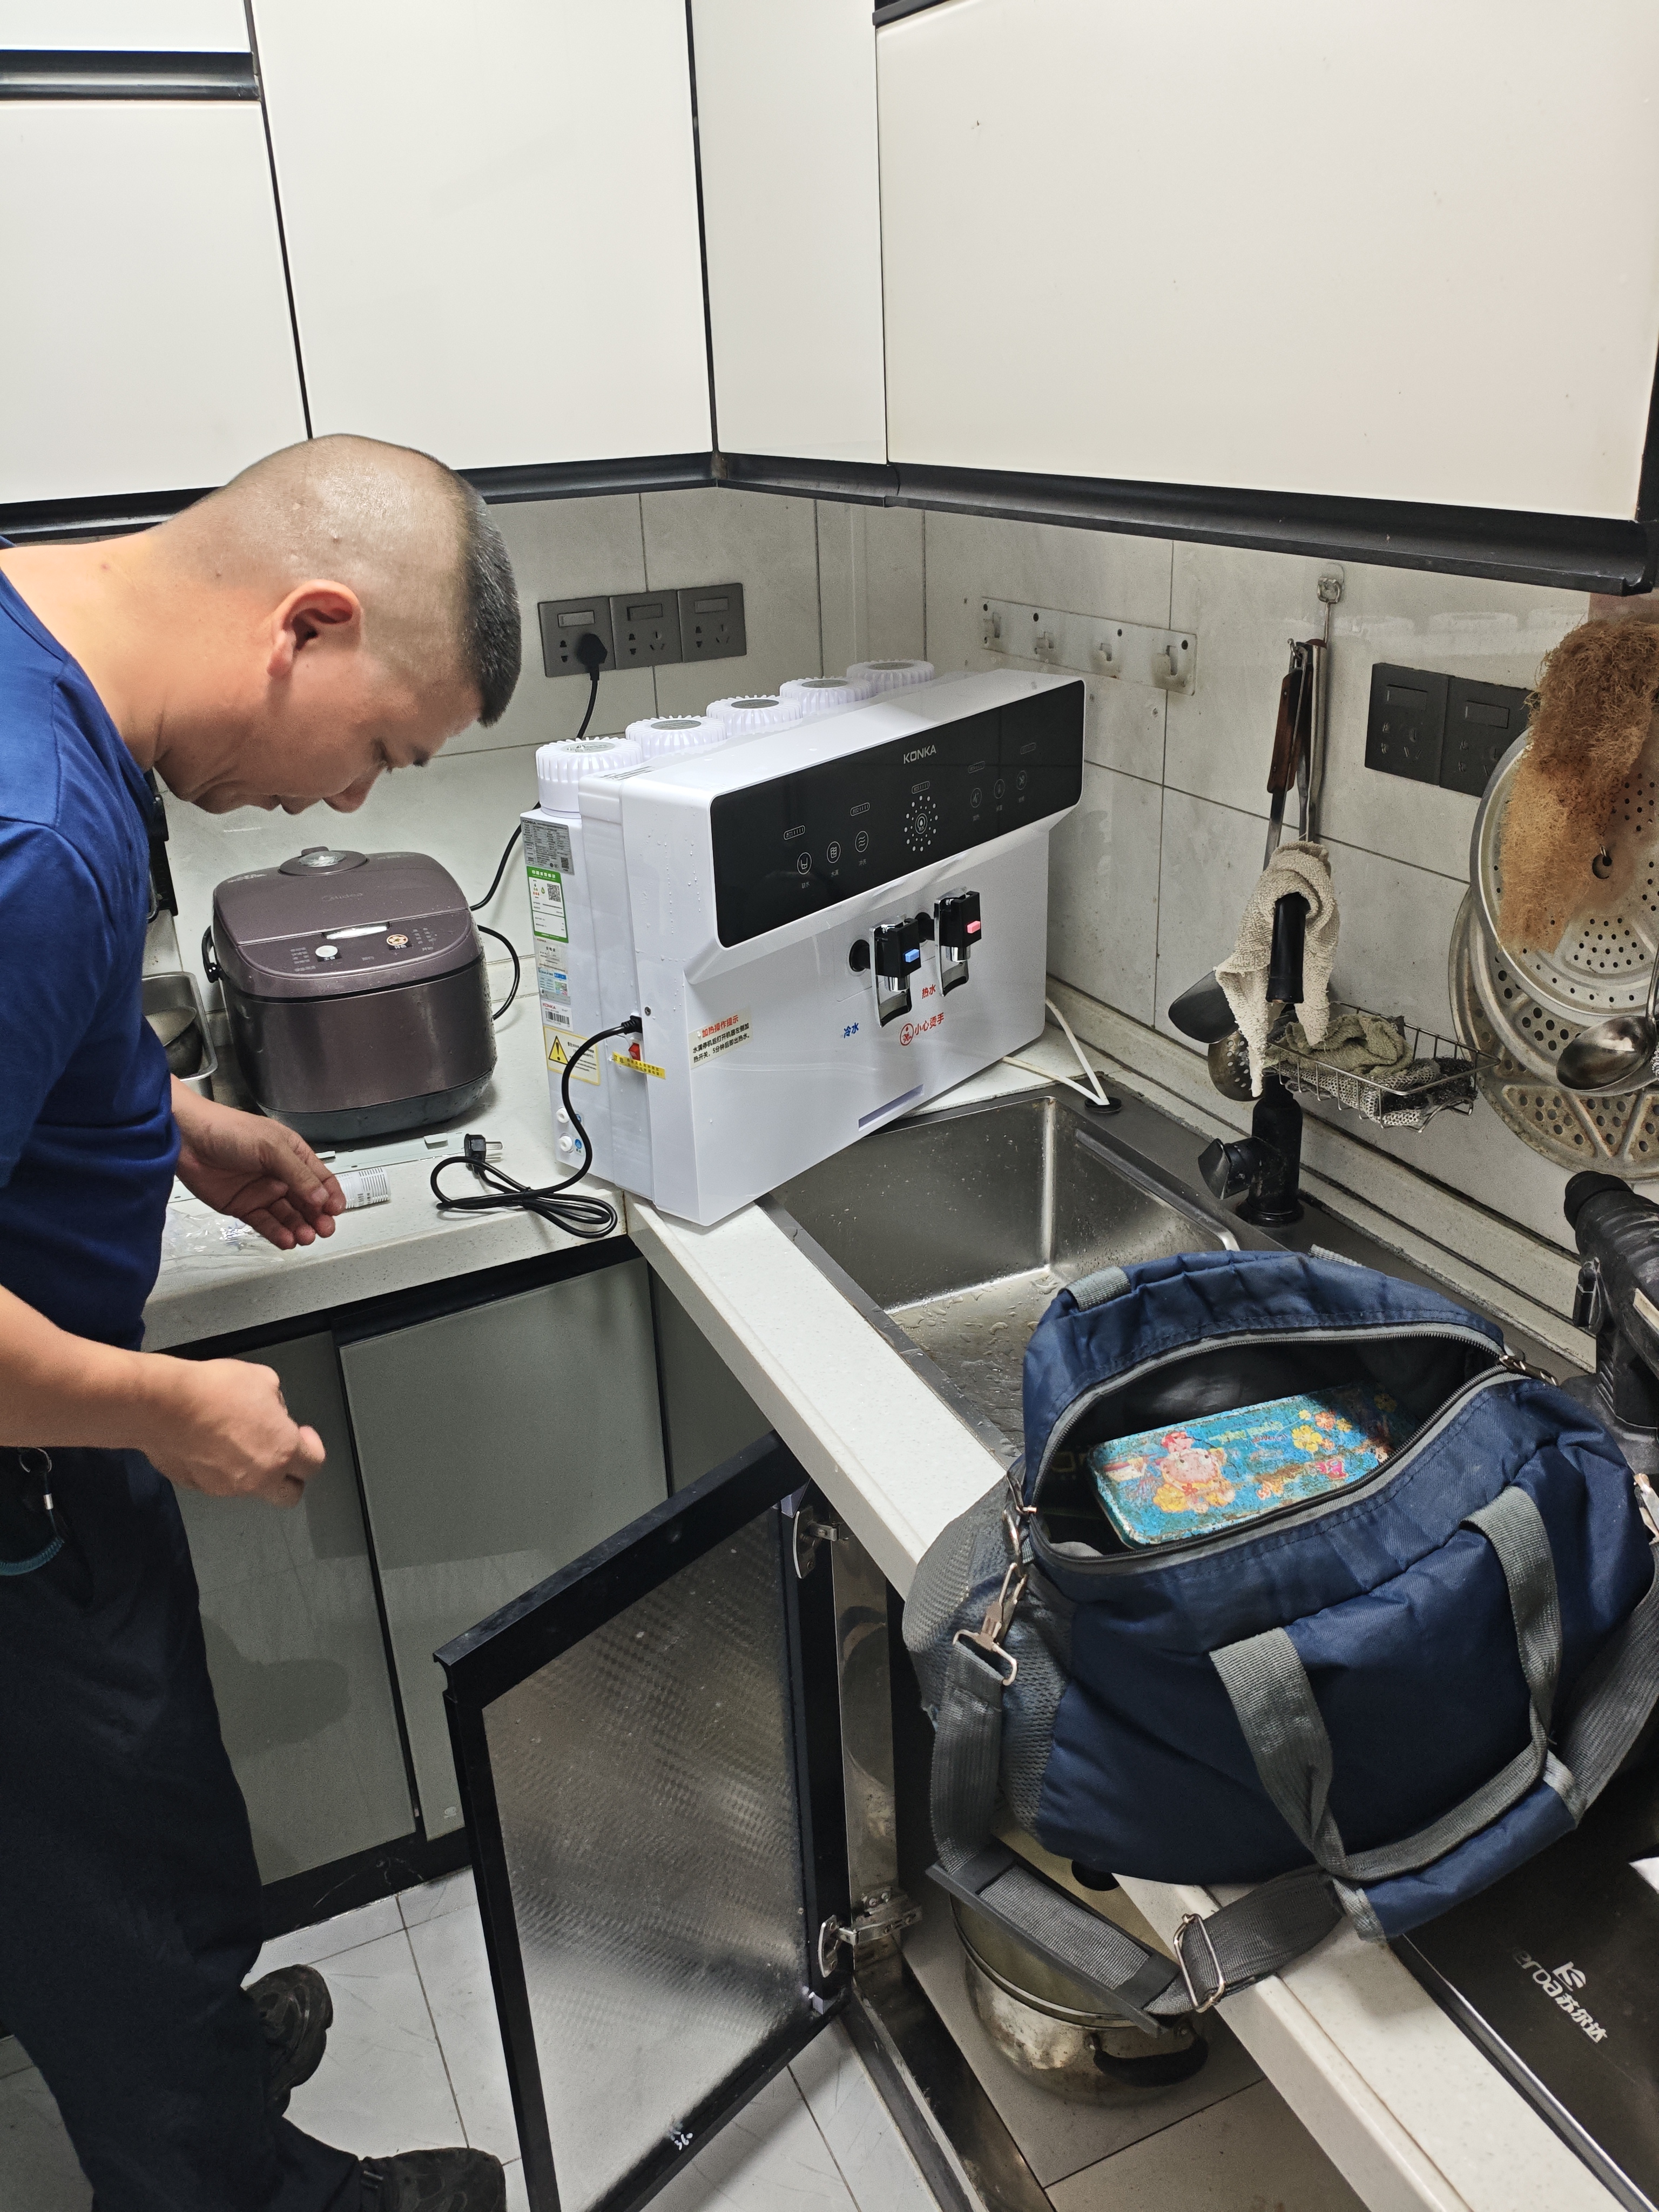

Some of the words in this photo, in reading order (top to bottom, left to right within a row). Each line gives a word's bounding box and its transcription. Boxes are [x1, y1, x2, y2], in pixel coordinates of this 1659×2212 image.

[903, 745, 936, 764] KONKA
[922, 984, 936, 999] 热水
[702, 1015, 739, 1038] 加热操作提示
[844, 1022, 859, 1038] 冷水
[914, 1012, 945, 1036] 小心烫手
